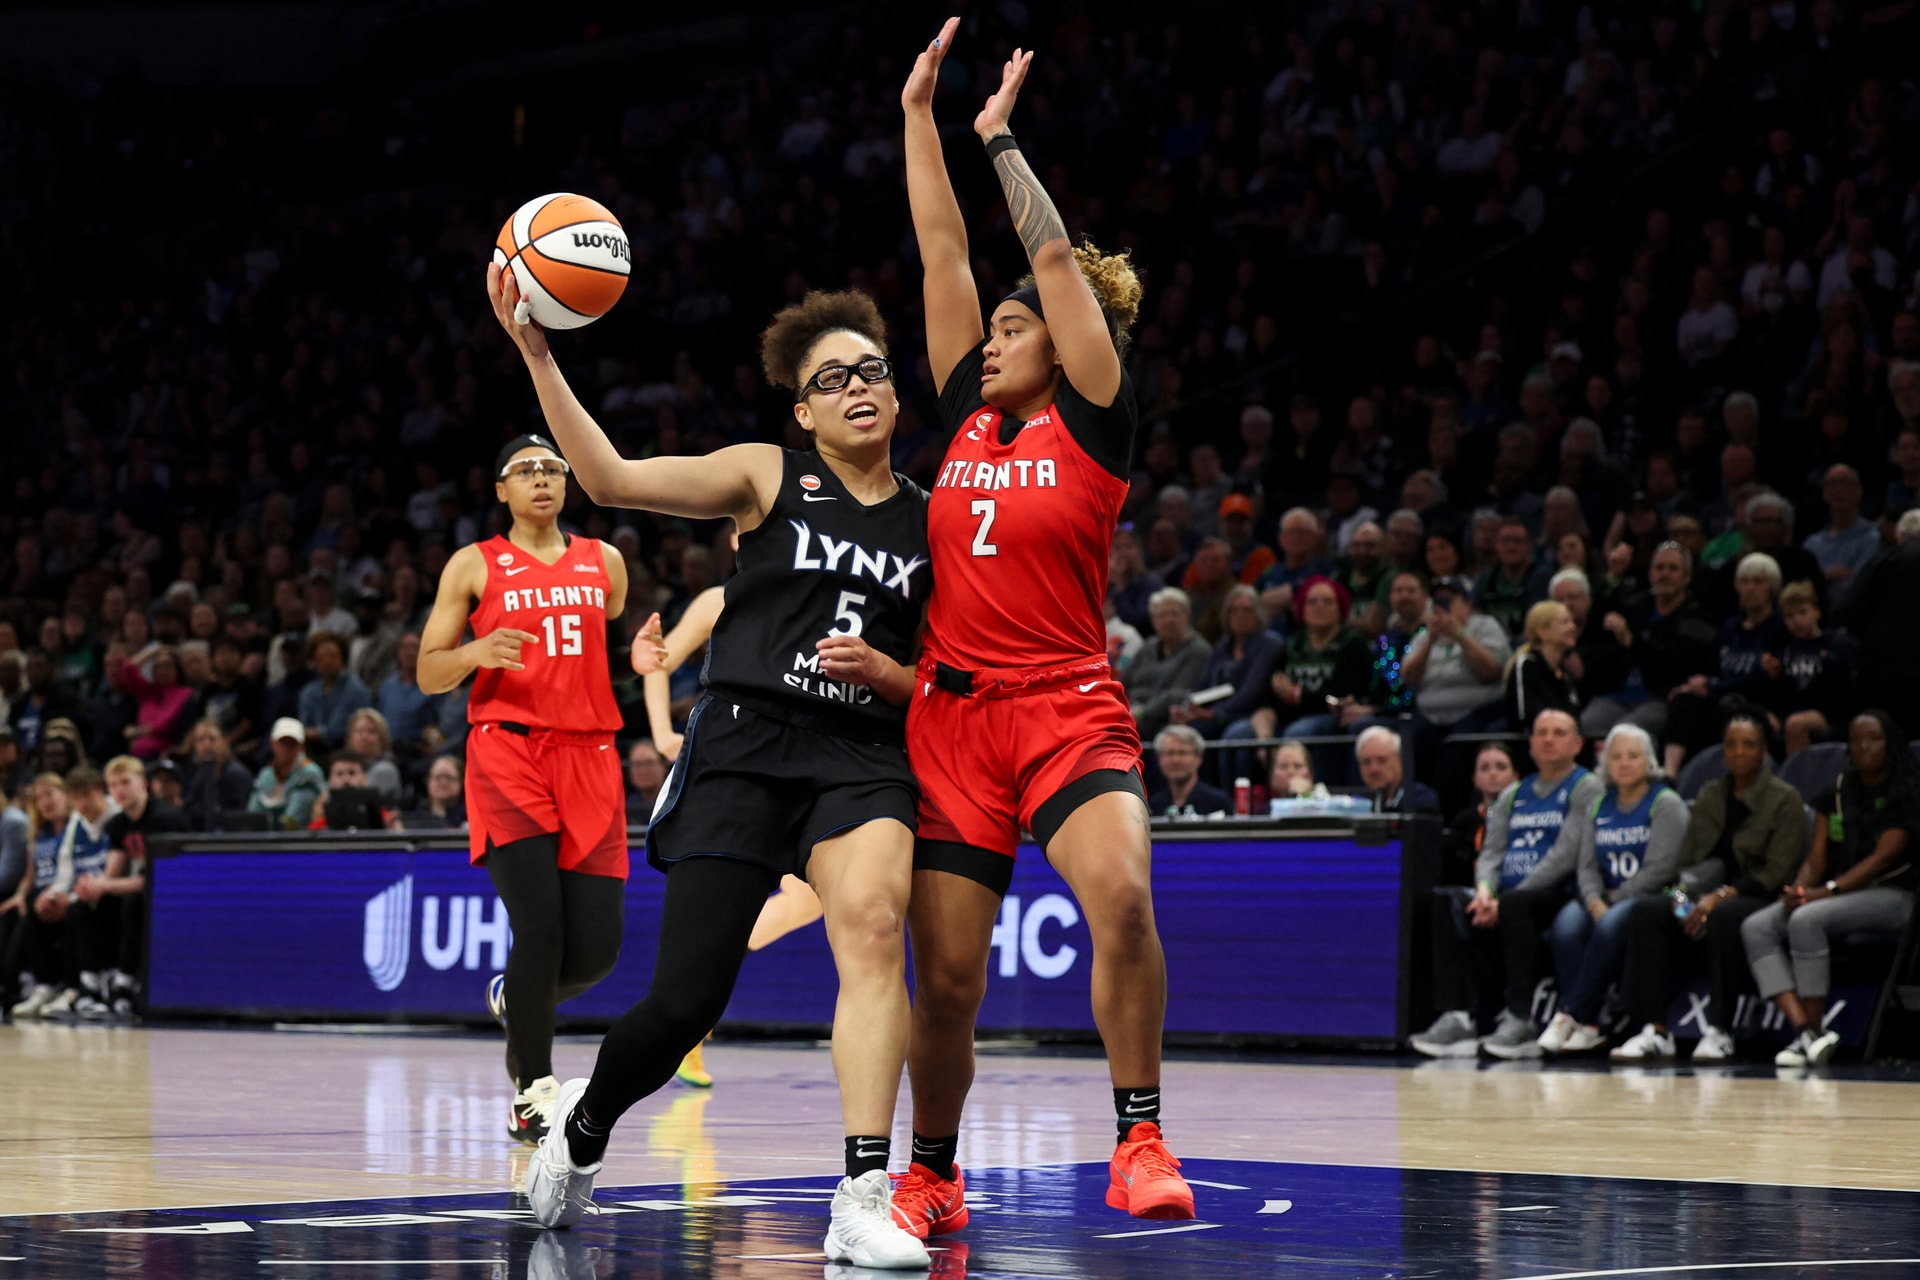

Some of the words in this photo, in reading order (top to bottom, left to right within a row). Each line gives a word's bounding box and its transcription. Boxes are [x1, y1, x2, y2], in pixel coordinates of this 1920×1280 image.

[1024, 414, 1052, 430] bert
[937, 458, 1057, 491] ATLANTA
[970, 498, 998, 557] 2
[788, 519, 929, 600] LYNX
[503, 585, 605, 613] ATLANTA
[826, 590, 867, 638] 5
[541, 614, 583, 657] 15
[1606, 851, 1640, 879] 10
[421, 895, 514, 971] UH
[990, 893, 1080, 980] HC
